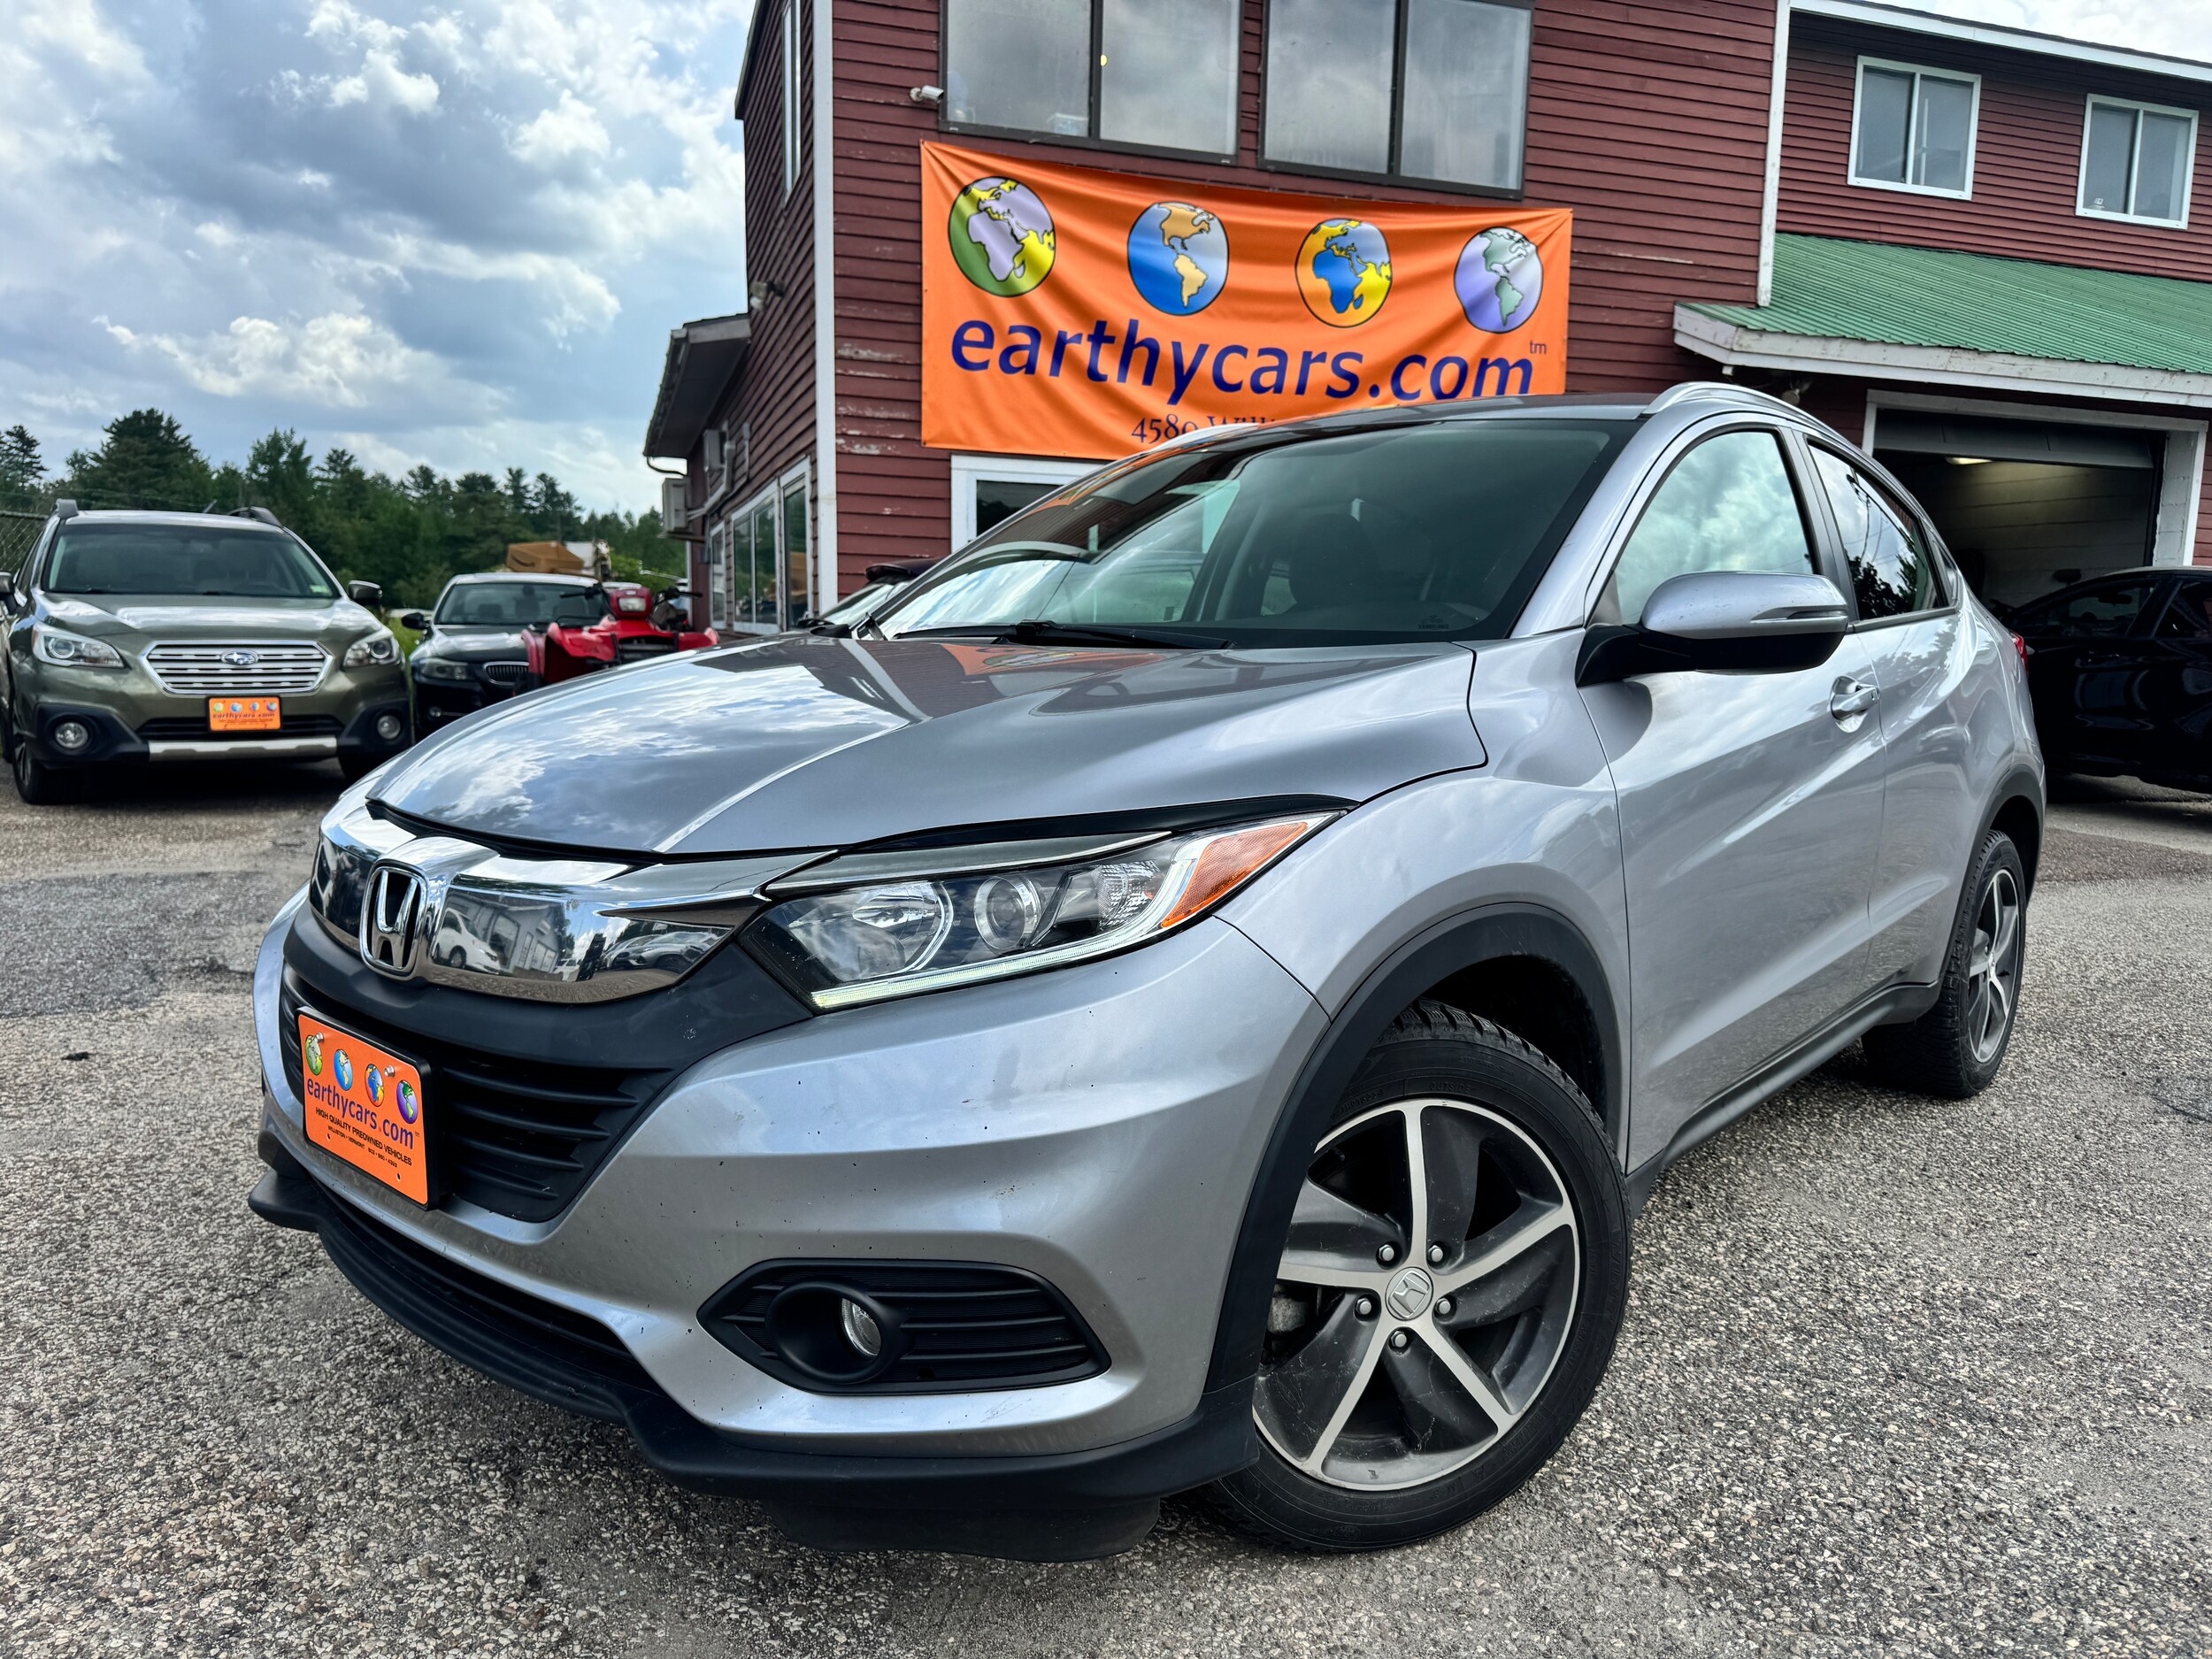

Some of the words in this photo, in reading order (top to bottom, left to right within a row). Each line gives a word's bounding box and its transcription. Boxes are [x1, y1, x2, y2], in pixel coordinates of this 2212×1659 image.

[951, 318, 1533, 406] earthycars.com
[307, 1078, 413, 1149] earthycars.com
[329, 1114, 351, 1132] QUALITY
[384, 1144, 412, 1166] VEHICLES
